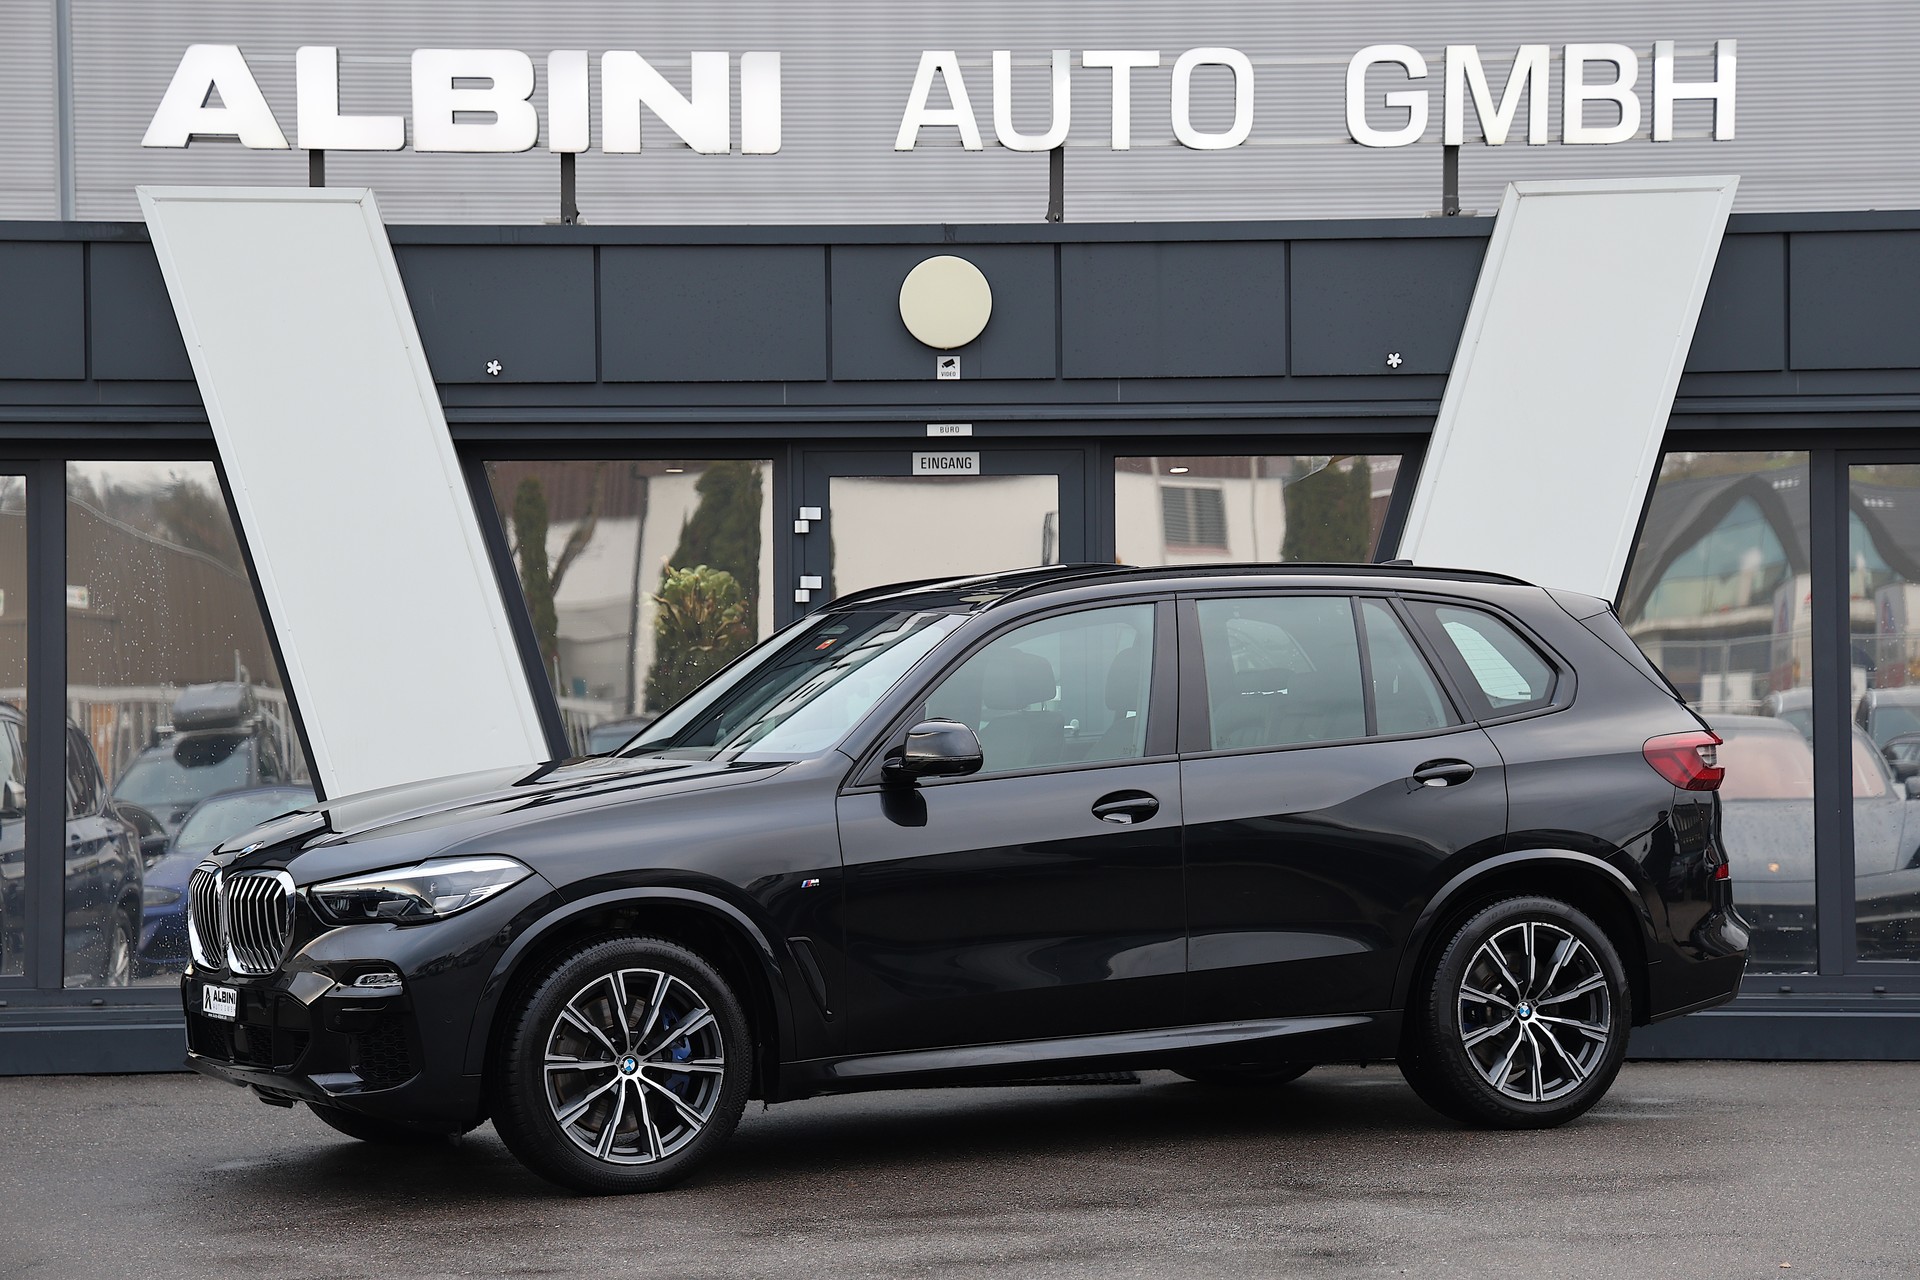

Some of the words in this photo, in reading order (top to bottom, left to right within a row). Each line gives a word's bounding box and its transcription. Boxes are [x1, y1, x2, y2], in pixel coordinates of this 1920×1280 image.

[141, 43, 782, 155] ALBINI
[894, 47, 1256, 152] AUTO
[1345, 38, 1738, 150] GMBH
[939, 425, 960, 433] BÜRO
[921, 457, 972, 469] EINGANG
[213, 990, 236, 1004] ALBINI
